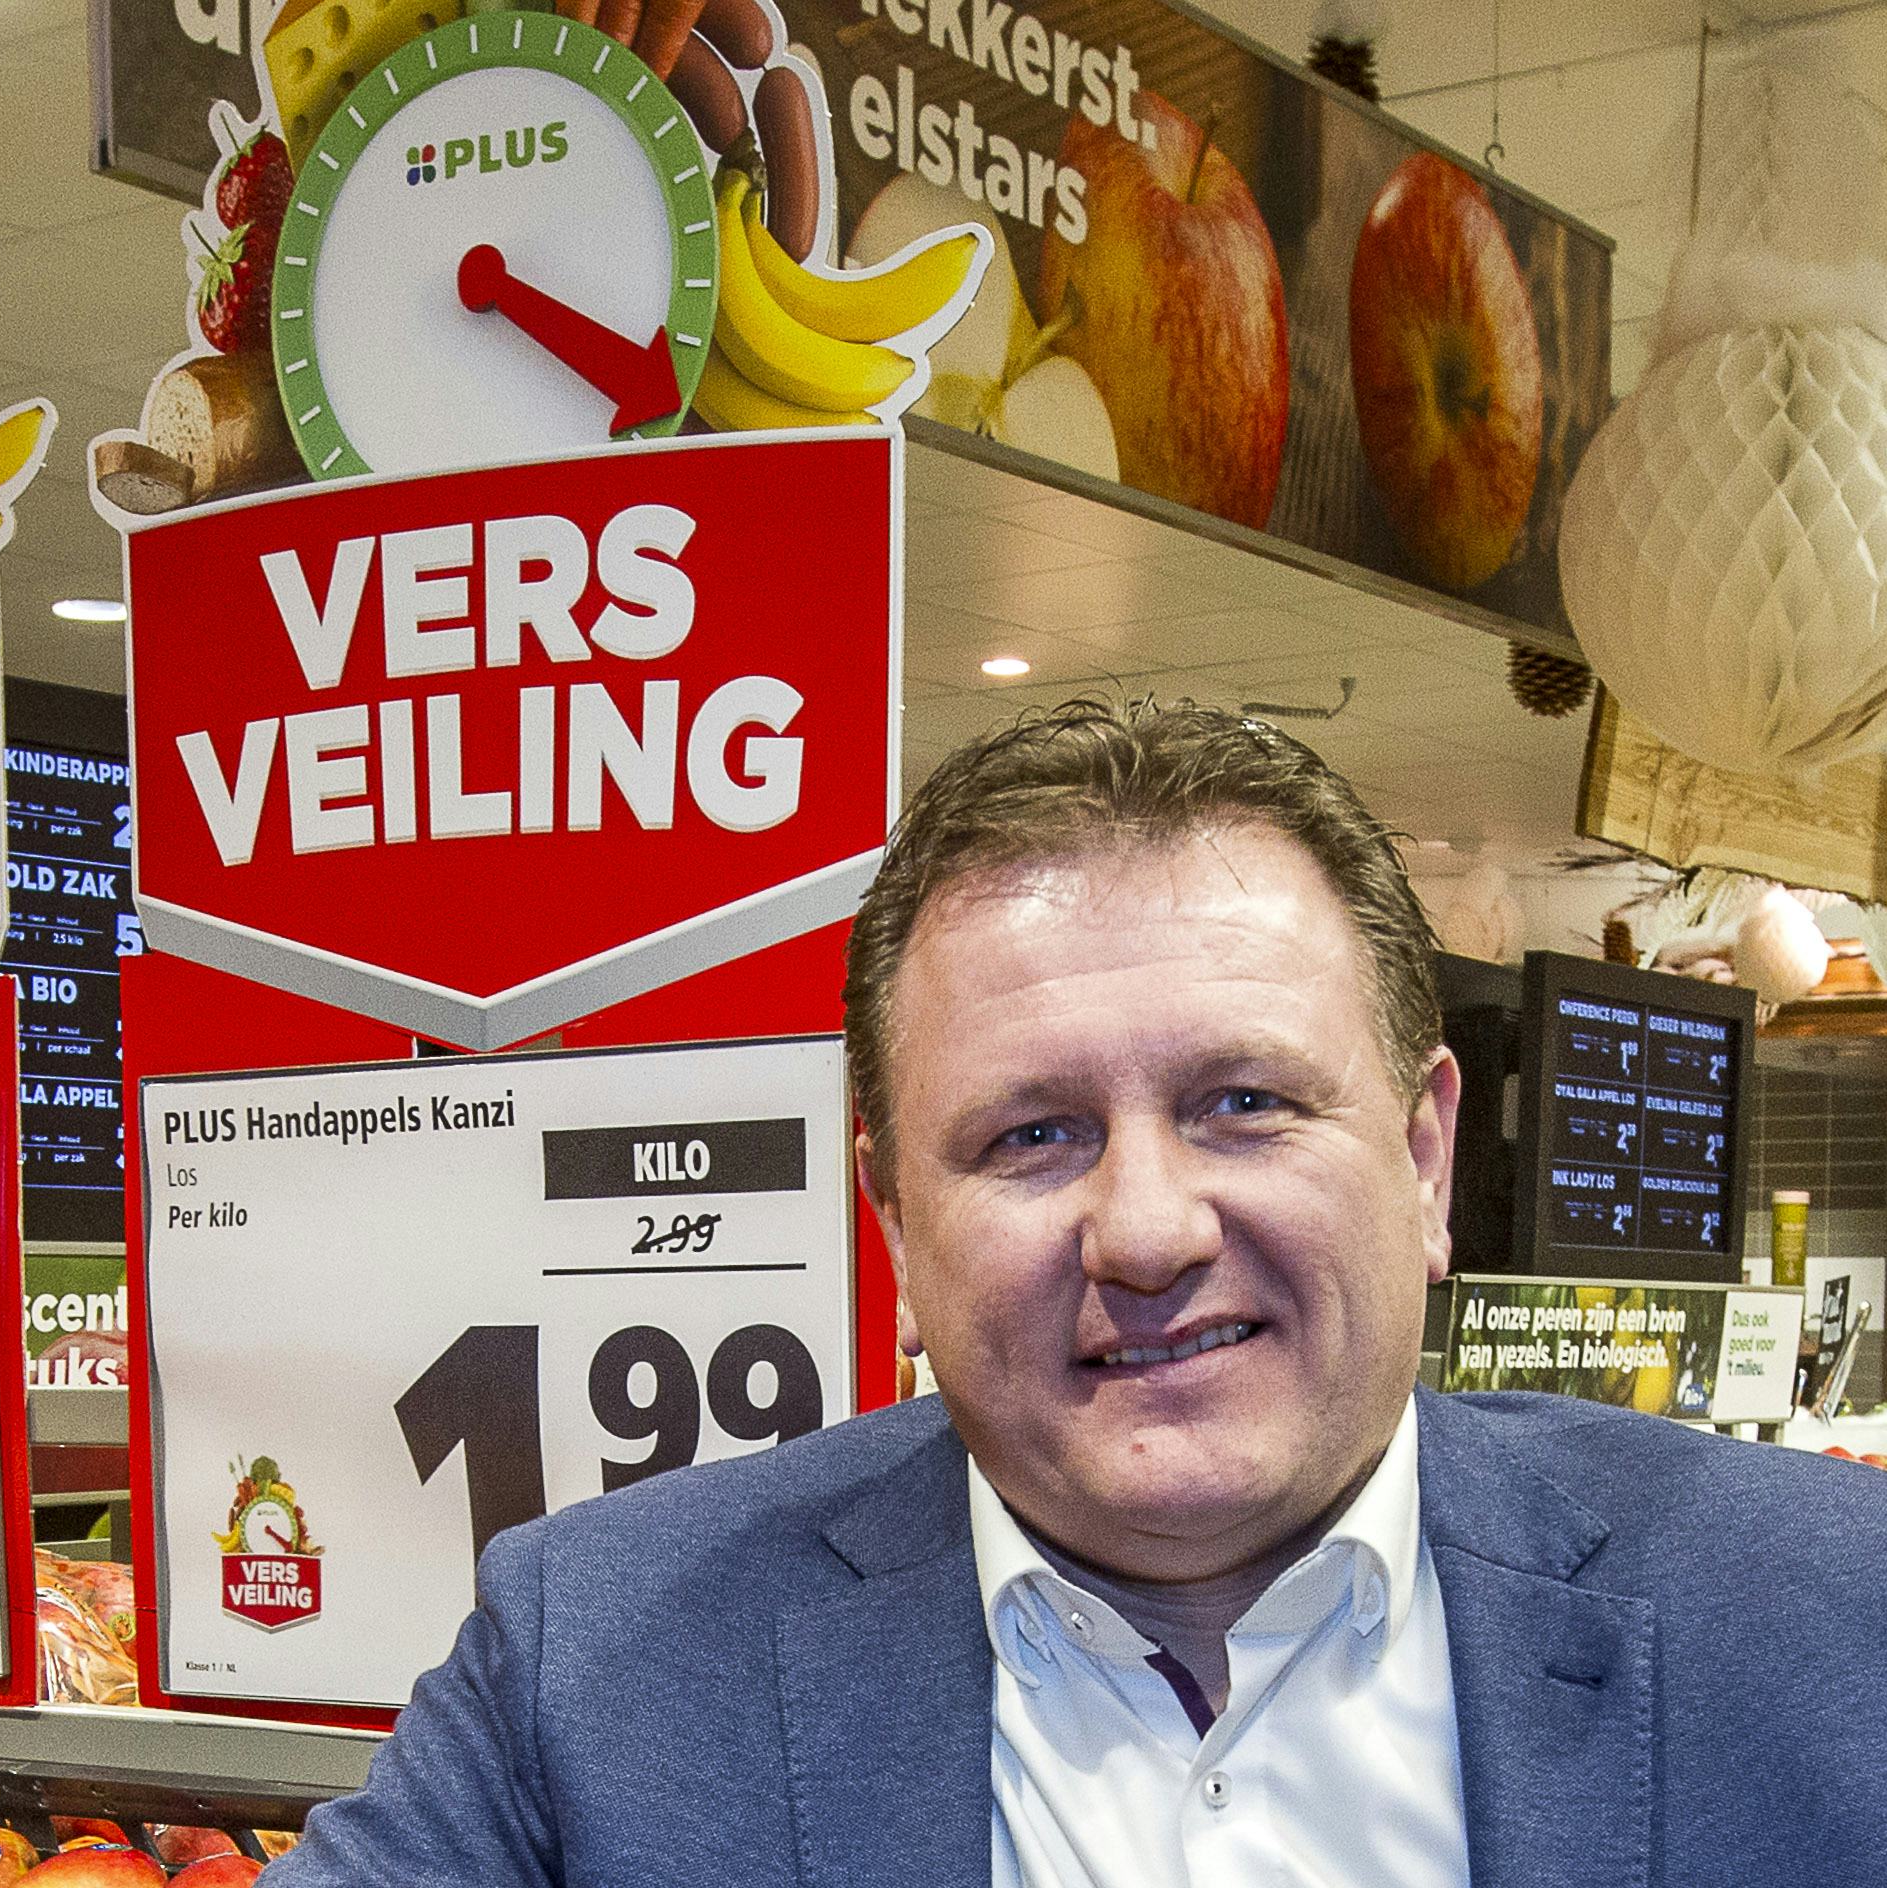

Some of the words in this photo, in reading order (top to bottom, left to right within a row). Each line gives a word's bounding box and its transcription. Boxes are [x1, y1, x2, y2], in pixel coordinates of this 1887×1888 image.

[860, 0, 1158, 152] kkerst.
[444, 121, 569, 180] PLUS
[850, 65, 1089, 246] elstars
[259, 503, 698, 692] VERS
[176, 674, 805, 868] VEILING
[62, 869, 117, 900] ZAK
[114, 913, 143, 956] 5
[32, 975, 77, 1004] BIO
[53, 1085, 119, 1109] APPEL
[164, 1107, 237, 1145] PLUS
[246, 1095, 421, 1145] Handappels
[431, 1090, 515, 1131] Kanzi
[167, 1163, 197, 1188] Los
[633, 1139, 711, 1183] KILO
[1571, 1171, 1595, 1189] LADY
[1598, 1174, 1615, 1190] LOS
[168, 1205, 202, 1229] Per
[208, 1202, 248, 1228] kilo
[631, 1213, 722, 1256] 2.99
[1462, 1299, 1482, 1330] Al
[1487, 1307, 1530, 1330] onze
[1532, 1306, 1582, 1336] peren
[1585, 1302, 1614, 1336] zijn
[1617, 1308, 1646, 1332] een
[1648, 1306, 1686, 1333] bron
[1752, 1310, 1769, 1328] ook
[1459, 1343, 1492, 1369] van
[1497, 1342, 1553, 1369] vezels.
[1556, 1339, 1579, 1369] En
[1582, 1339, 1669, 1374] biologisch.
[1729, 1335, 1755, 1353] goed
[1757, 1337, 1776, 1352] voor
[241, 1561, 299, 1584] VERS
[228, 1584, 312, 1609] VEILING
